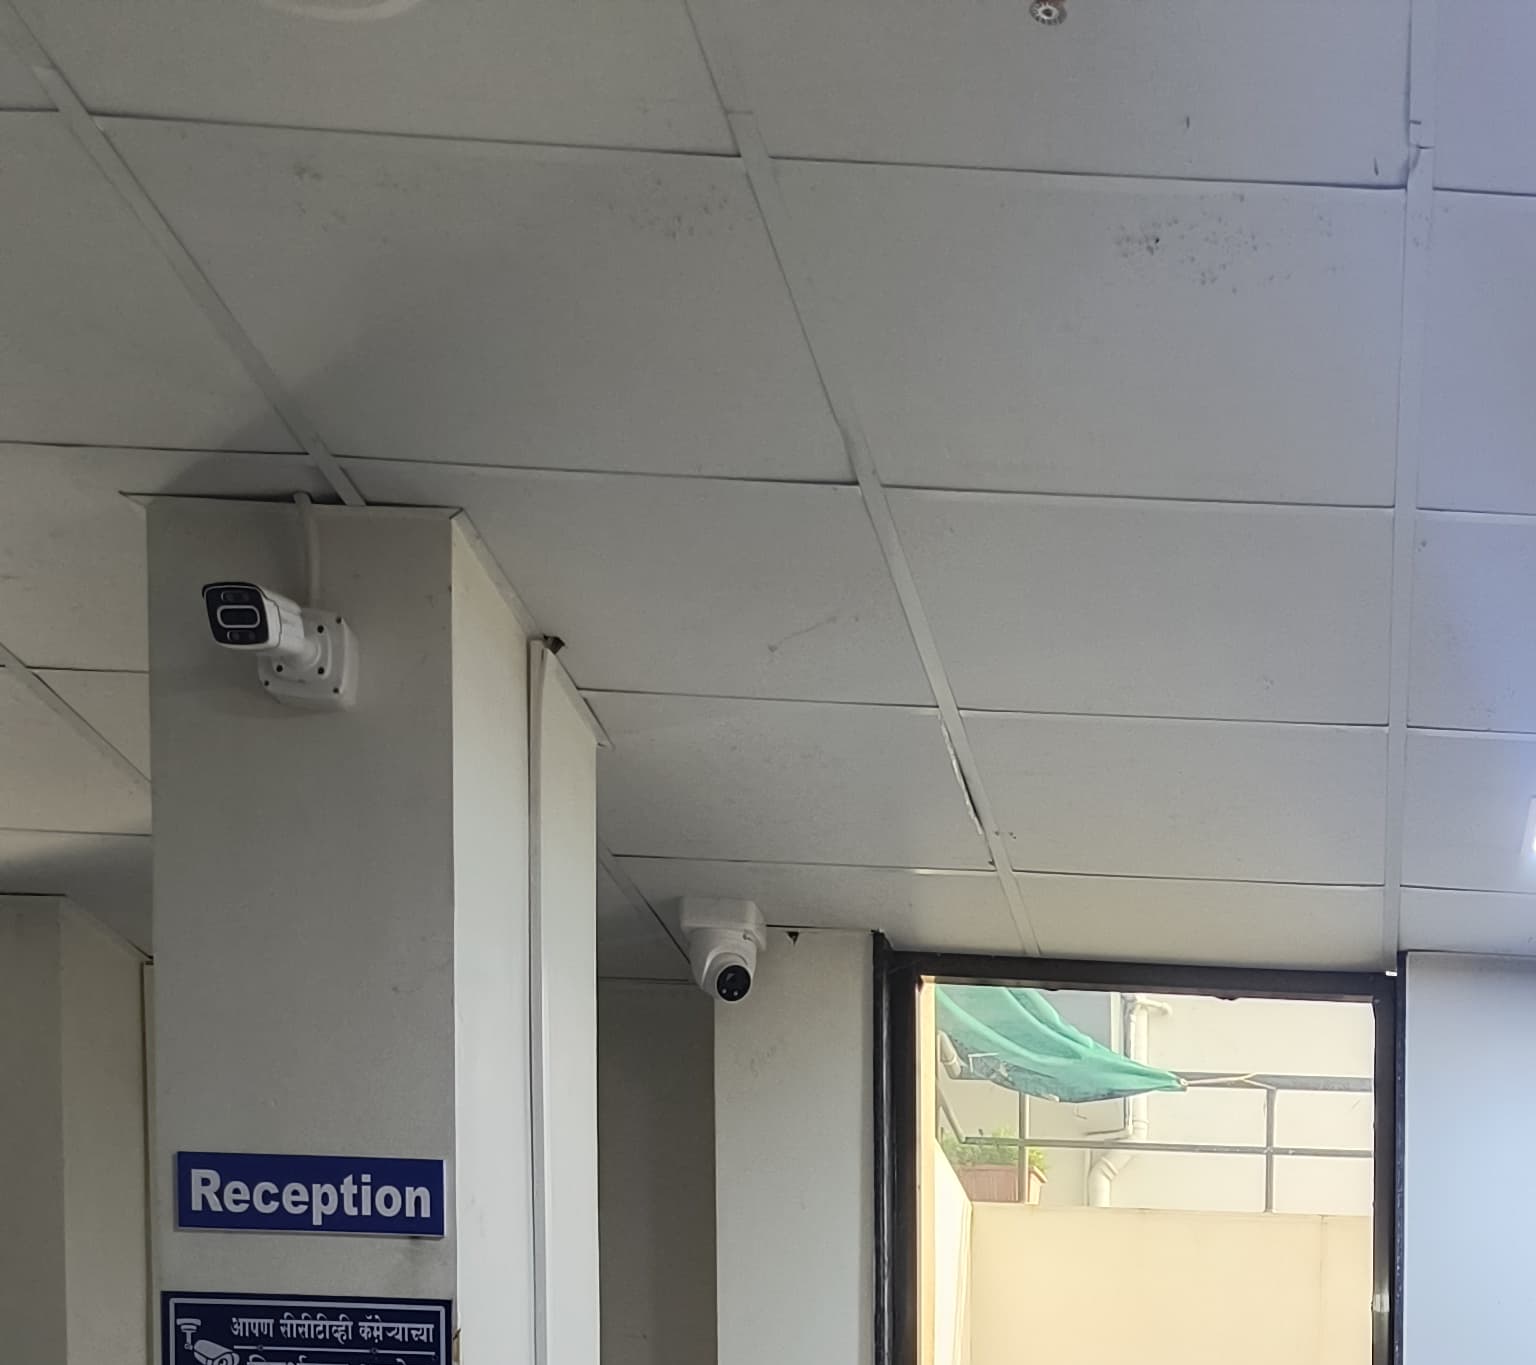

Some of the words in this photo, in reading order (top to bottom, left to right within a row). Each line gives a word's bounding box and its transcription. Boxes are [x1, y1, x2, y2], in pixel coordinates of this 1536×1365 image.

[190, 1168, 431, 1226] Reception
[230, 1317, 274, 1338] आपण
[279, 1312, 353, 1344] सीसीटीव्ही
